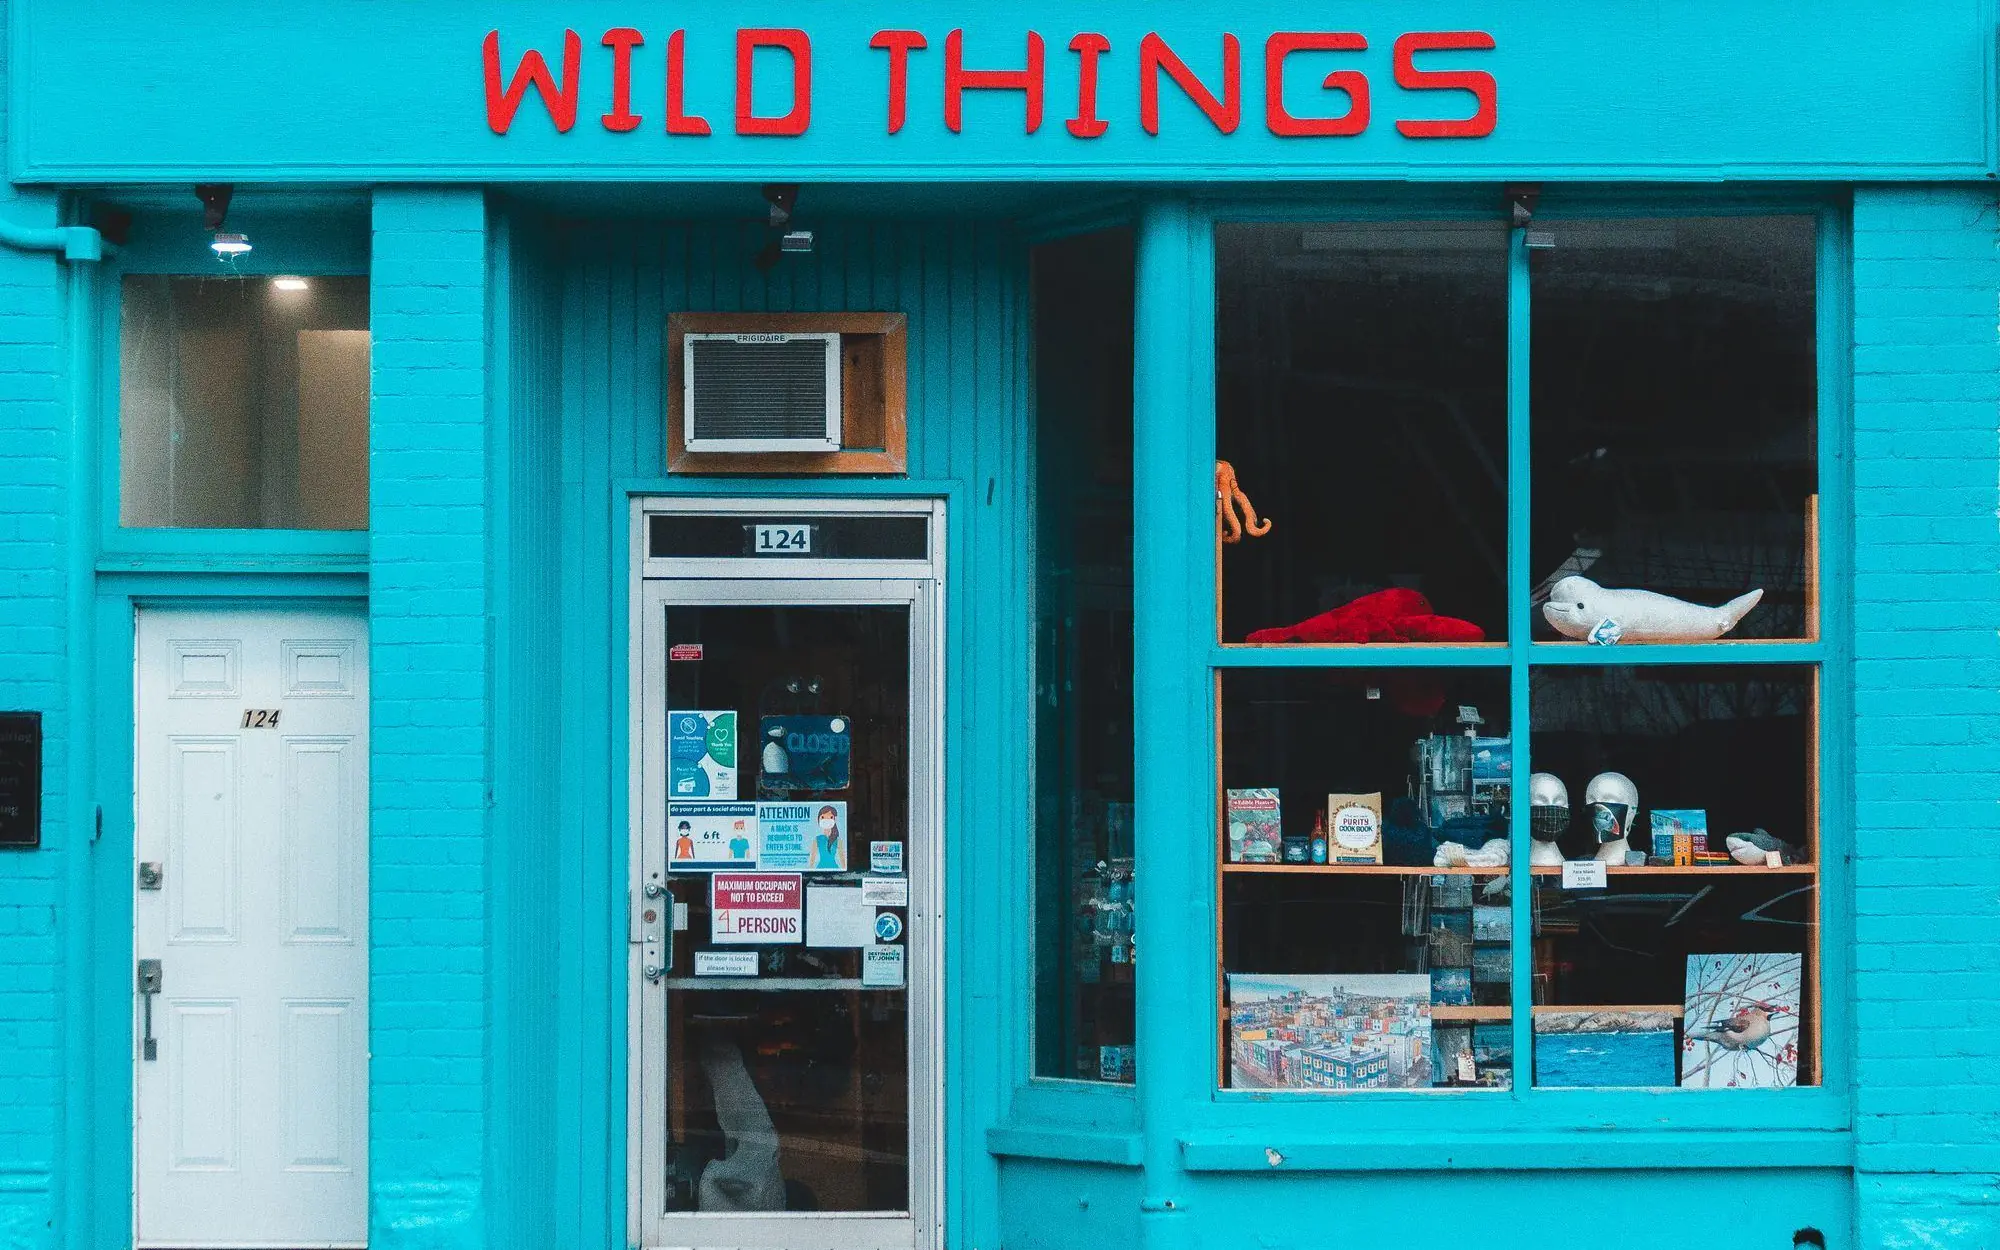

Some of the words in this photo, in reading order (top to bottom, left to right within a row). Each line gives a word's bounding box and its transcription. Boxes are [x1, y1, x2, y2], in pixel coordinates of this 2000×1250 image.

[482, 28, 812, 135] WILD
[869, 28, 1498, 138] THINGS
[760, 530, 806, 549] 124
[245, 710, 280, 727] 124
[787, 732, 849, 753] CLOSED
[759, 806, 811, 819] ATTENTION
[1343, 818, 1369, 826] PURITY
[703, 831, 709, 839] 6
[711, 831, 720, 839] ft
[795, 834, 803, 842] TO
[766, 843, 784, 851] ENTER
[717, 880, 754, 891] MAXIMUM
[754, 880, 797, 891] OCCUPANCY
[730, 892, 744, 902] NOT
[745, 892, 755, 902] TO
[756, 892, 785, 903] EXCEED
[738, 917, 797, 934] PERSONS
